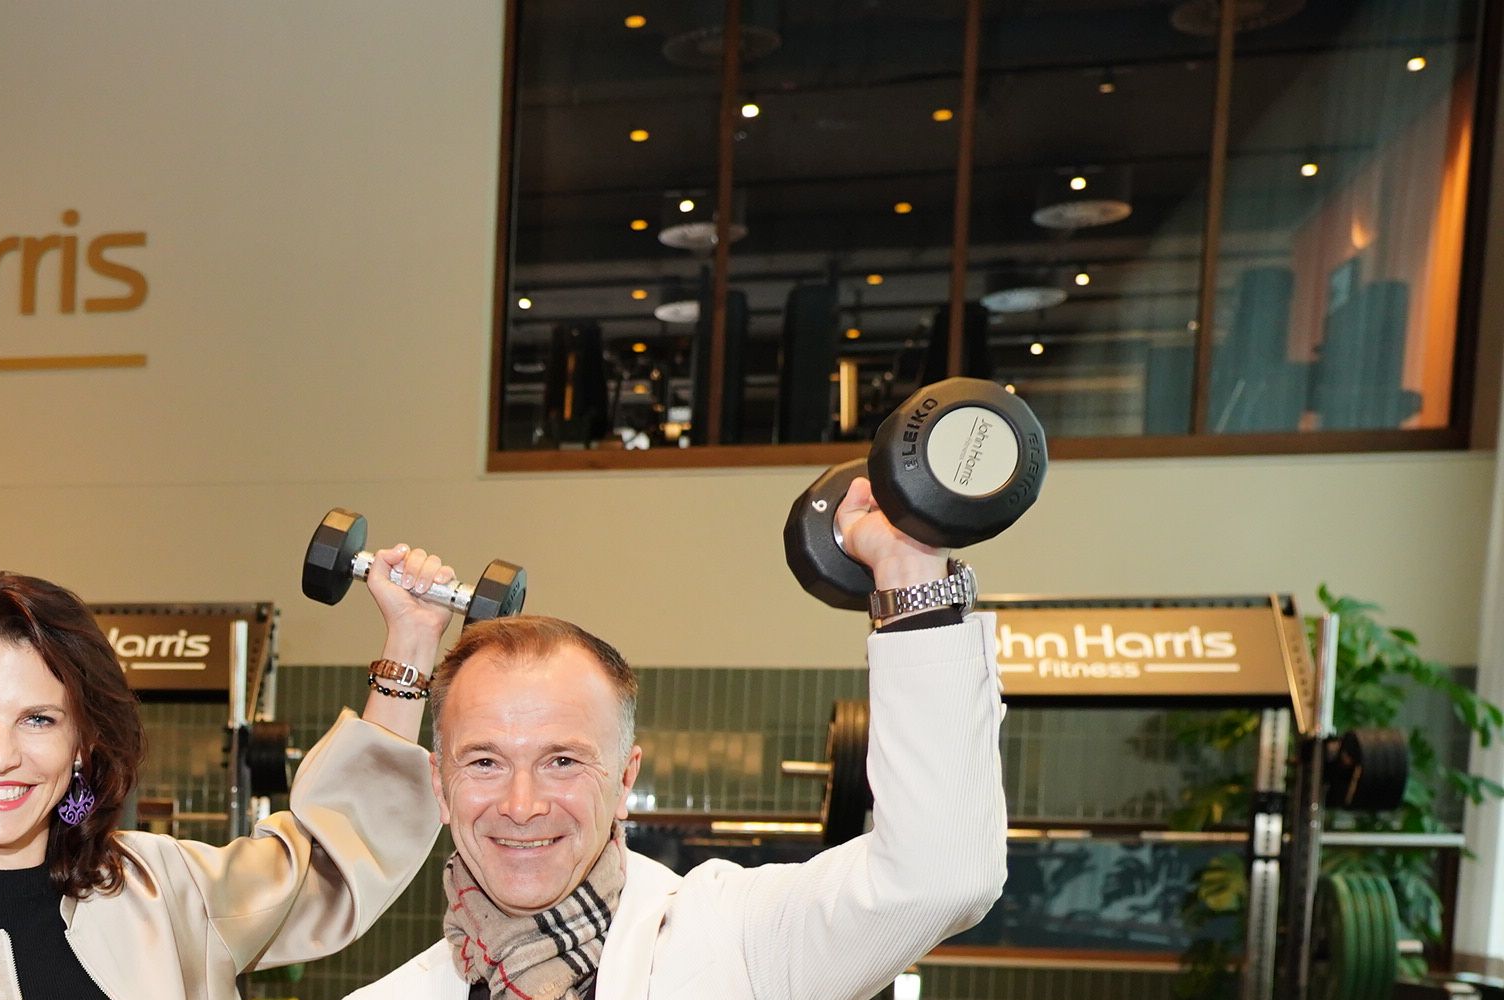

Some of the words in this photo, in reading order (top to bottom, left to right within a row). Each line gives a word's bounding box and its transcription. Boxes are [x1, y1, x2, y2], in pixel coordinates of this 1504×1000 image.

[901, 397, 938, 472] ELEIKO
[971, 418, 993, 449] John
[959, 446, 984, 486] Harris
[1007, 432, 1039, 506] ELEIKO
[1073, 624, 1238, 659] Harris
[1038, 657, 1141, 679] Fitness
